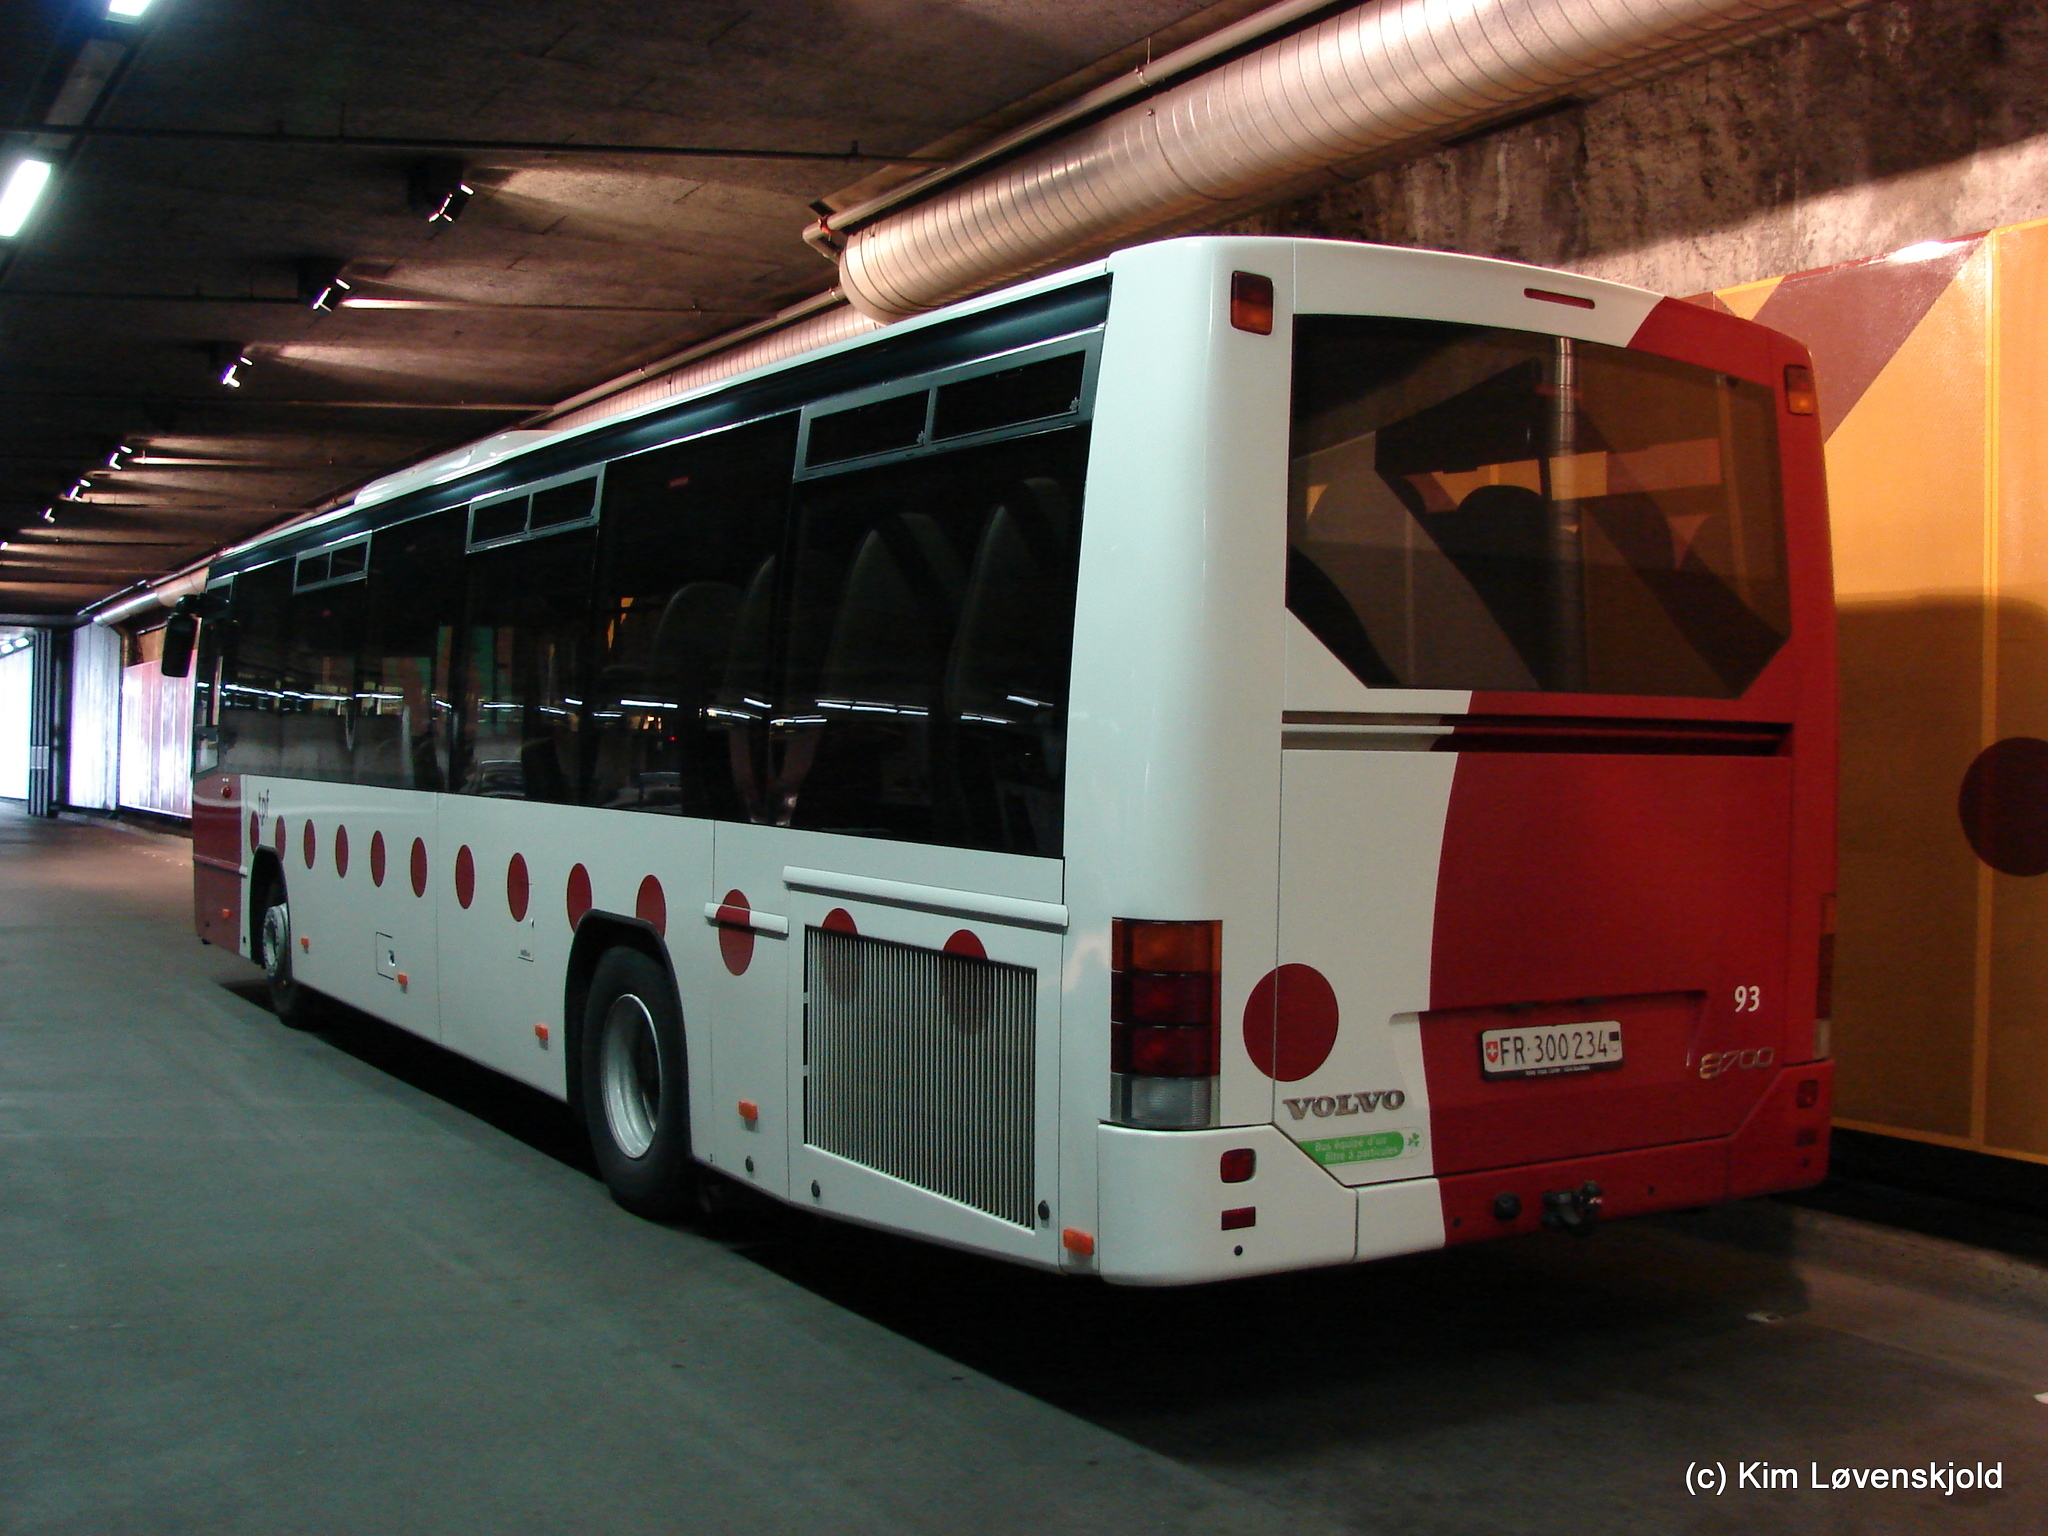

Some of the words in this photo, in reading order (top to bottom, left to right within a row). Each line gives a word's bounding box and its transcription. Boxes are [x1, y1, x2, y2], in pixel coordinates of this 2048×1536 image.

[1734, 985, 1760, 1013] 93
[1700, 1047, 1775, 1079] 8700
[1282, 1088, 1406, 1121] VOLVO
[1314, 1141, 1332, 1152] Bus
